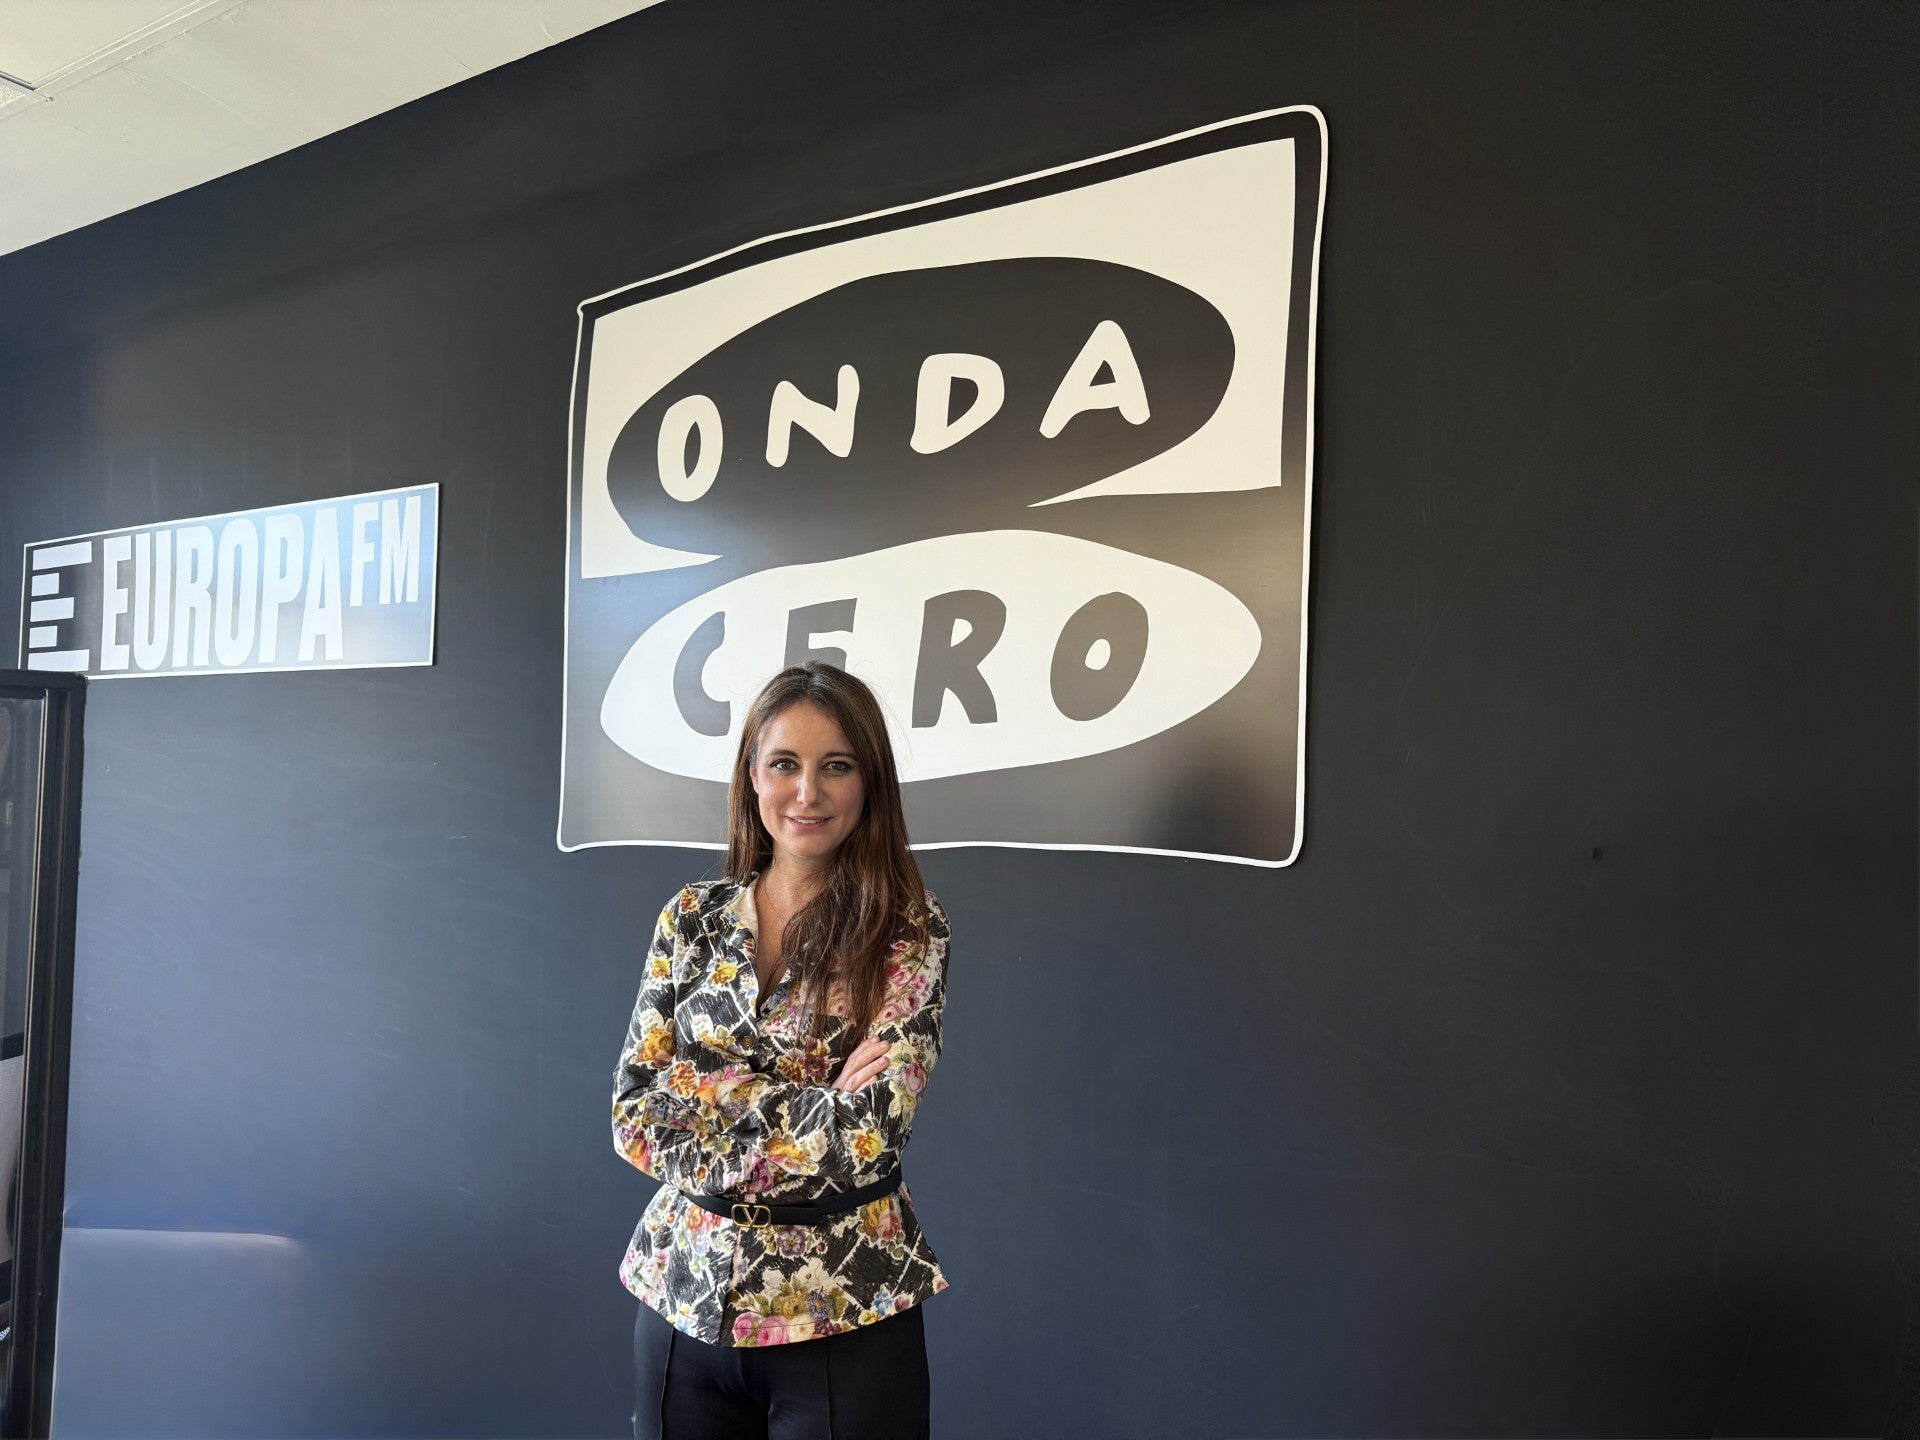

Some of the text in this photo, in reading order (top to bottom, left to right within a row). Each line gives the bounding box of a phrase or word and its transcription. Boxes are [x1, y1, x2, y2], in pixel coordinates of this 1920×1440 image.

[657, 320, 1150, 501] ONDA
[100, 495, 422, 671] EUROPA FM
